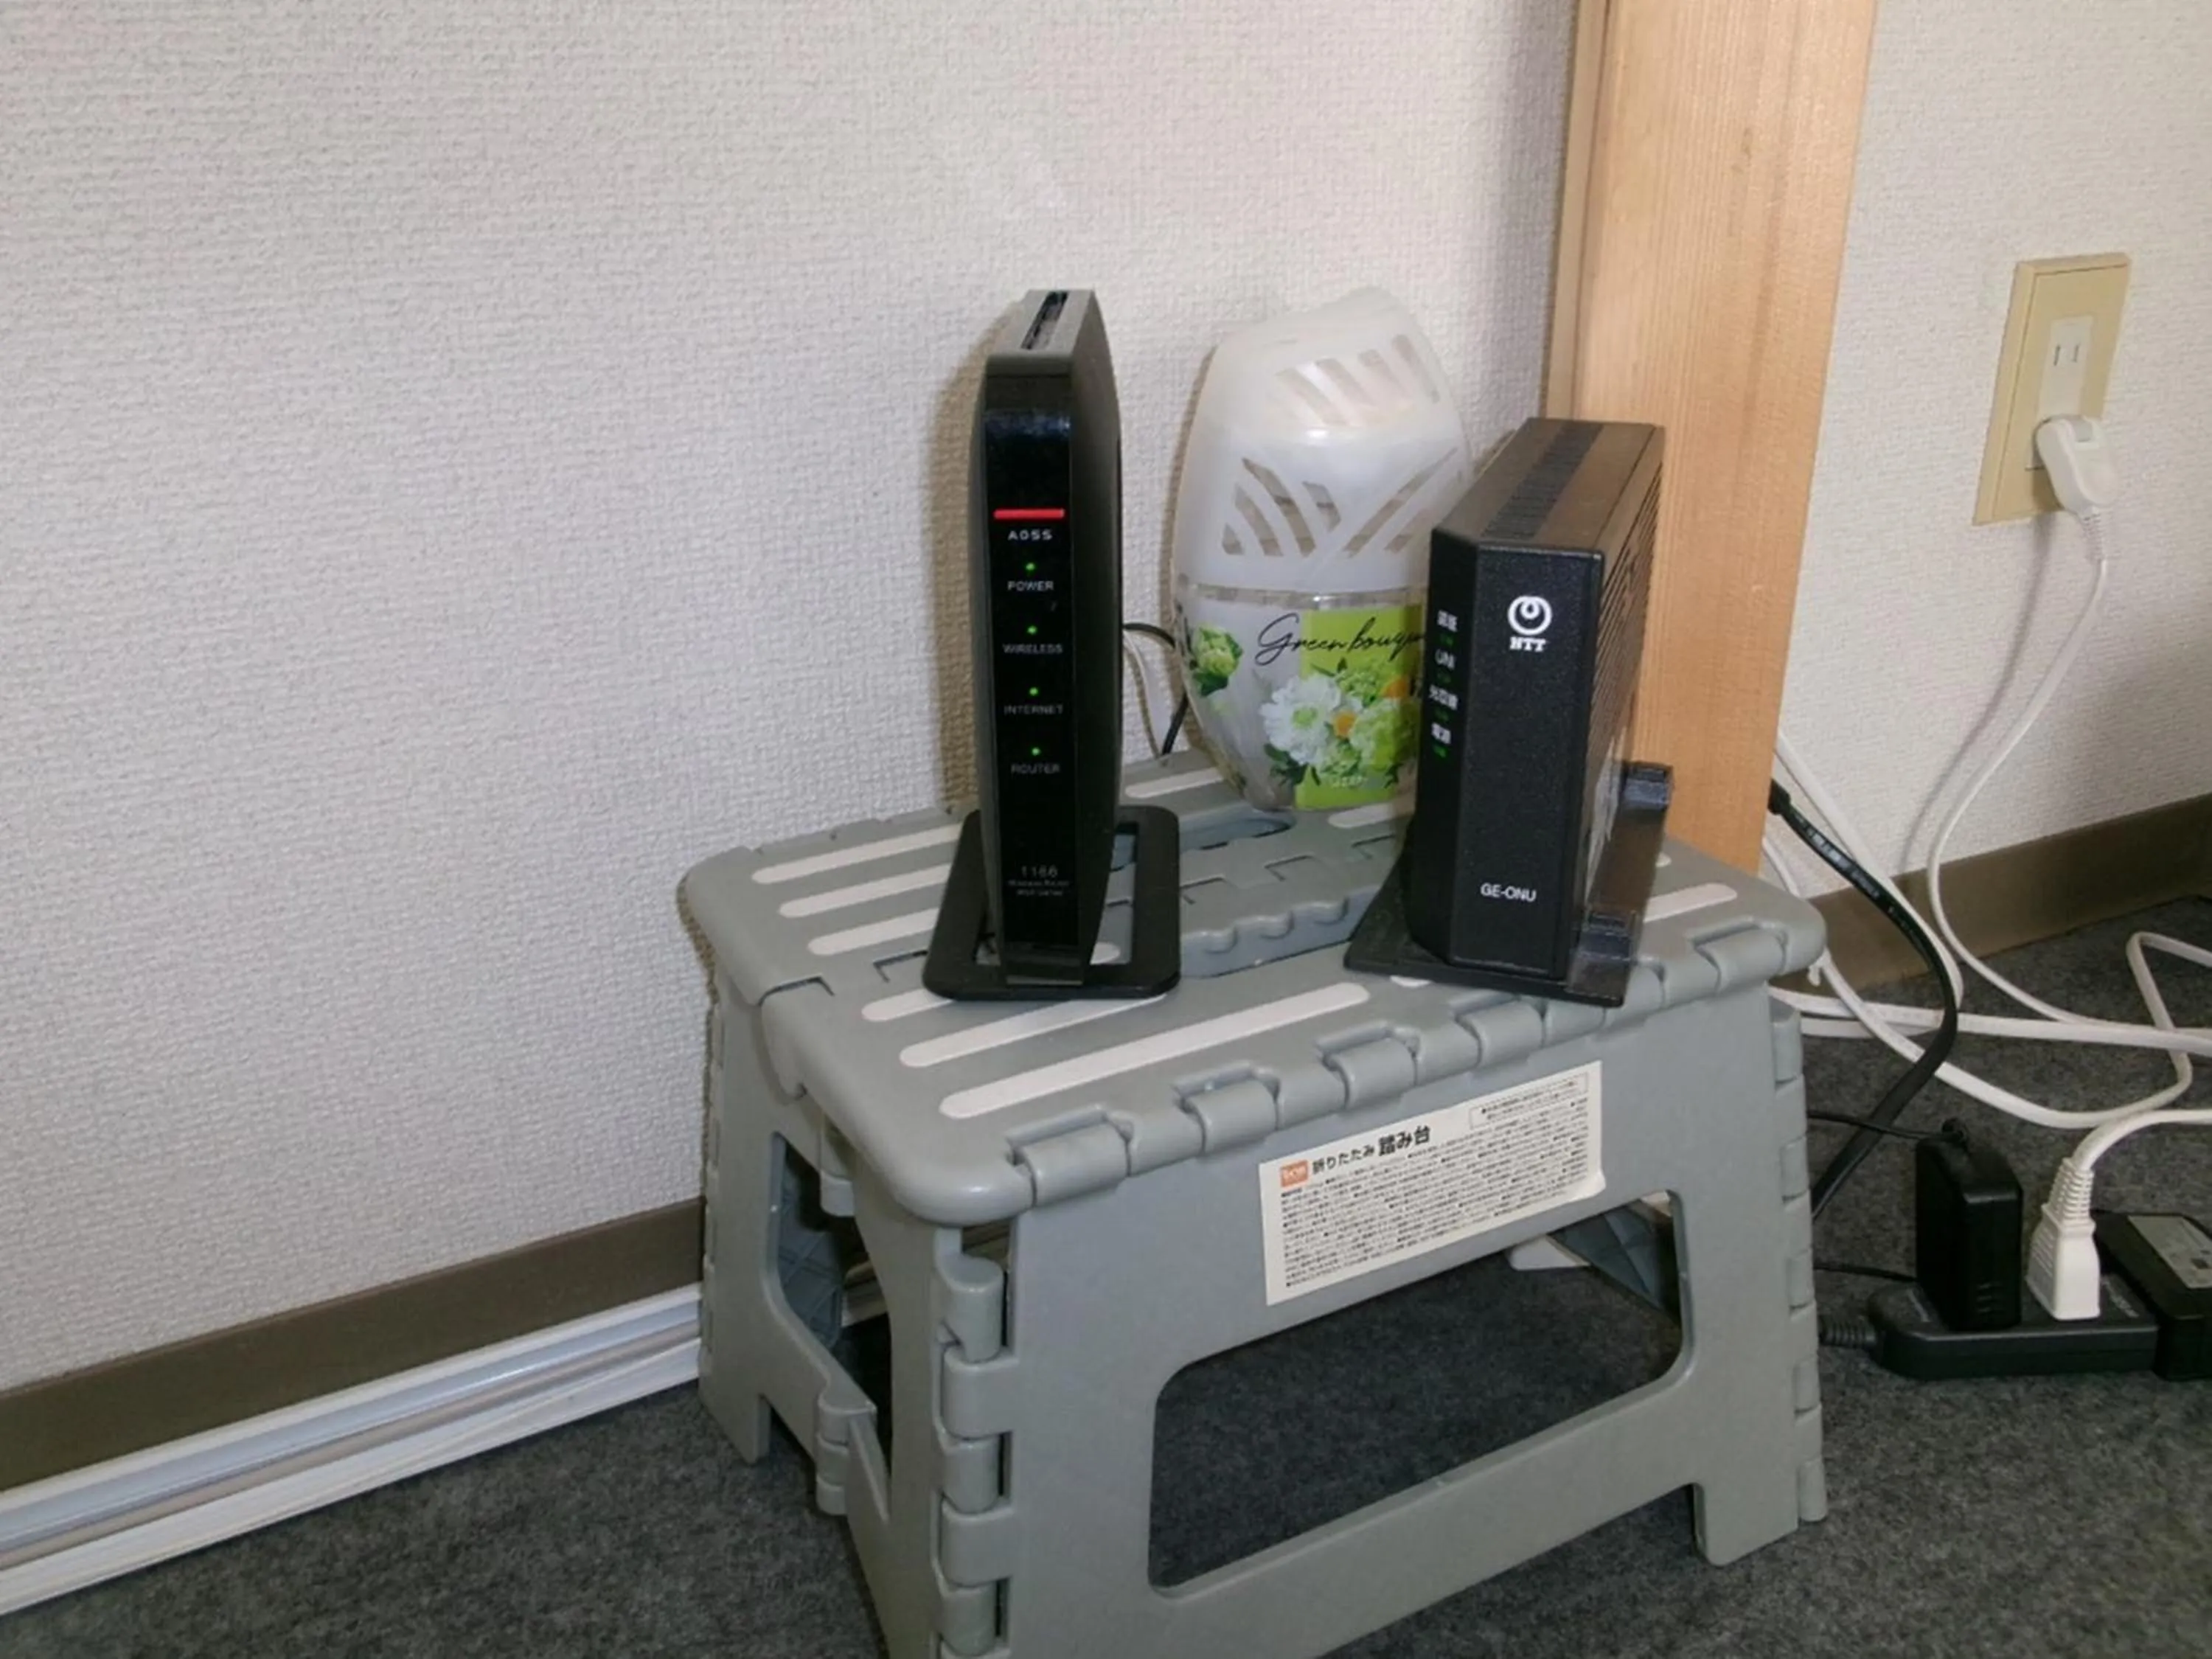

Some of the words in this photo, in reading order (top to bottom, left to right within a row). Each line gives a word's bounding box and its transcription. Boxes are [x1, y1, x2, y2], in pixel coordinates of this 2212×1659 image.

[1007, 529, 1053, 540] AOSS
[1007, 580, 1054, 591] POWER
[1254, 613, 1346, 666] Green
[1509, 636, 1546, 653] NTT
[1002, 643, 1063, 655] WIRELESS
[1004, 704, 1063, 716] INTERNET
[1011, 763, 1060, 775] ROUTER
[1480, 883, 1537, 902] GE-ONU
[1378, 1125, 1430, 1156] 踏み台
